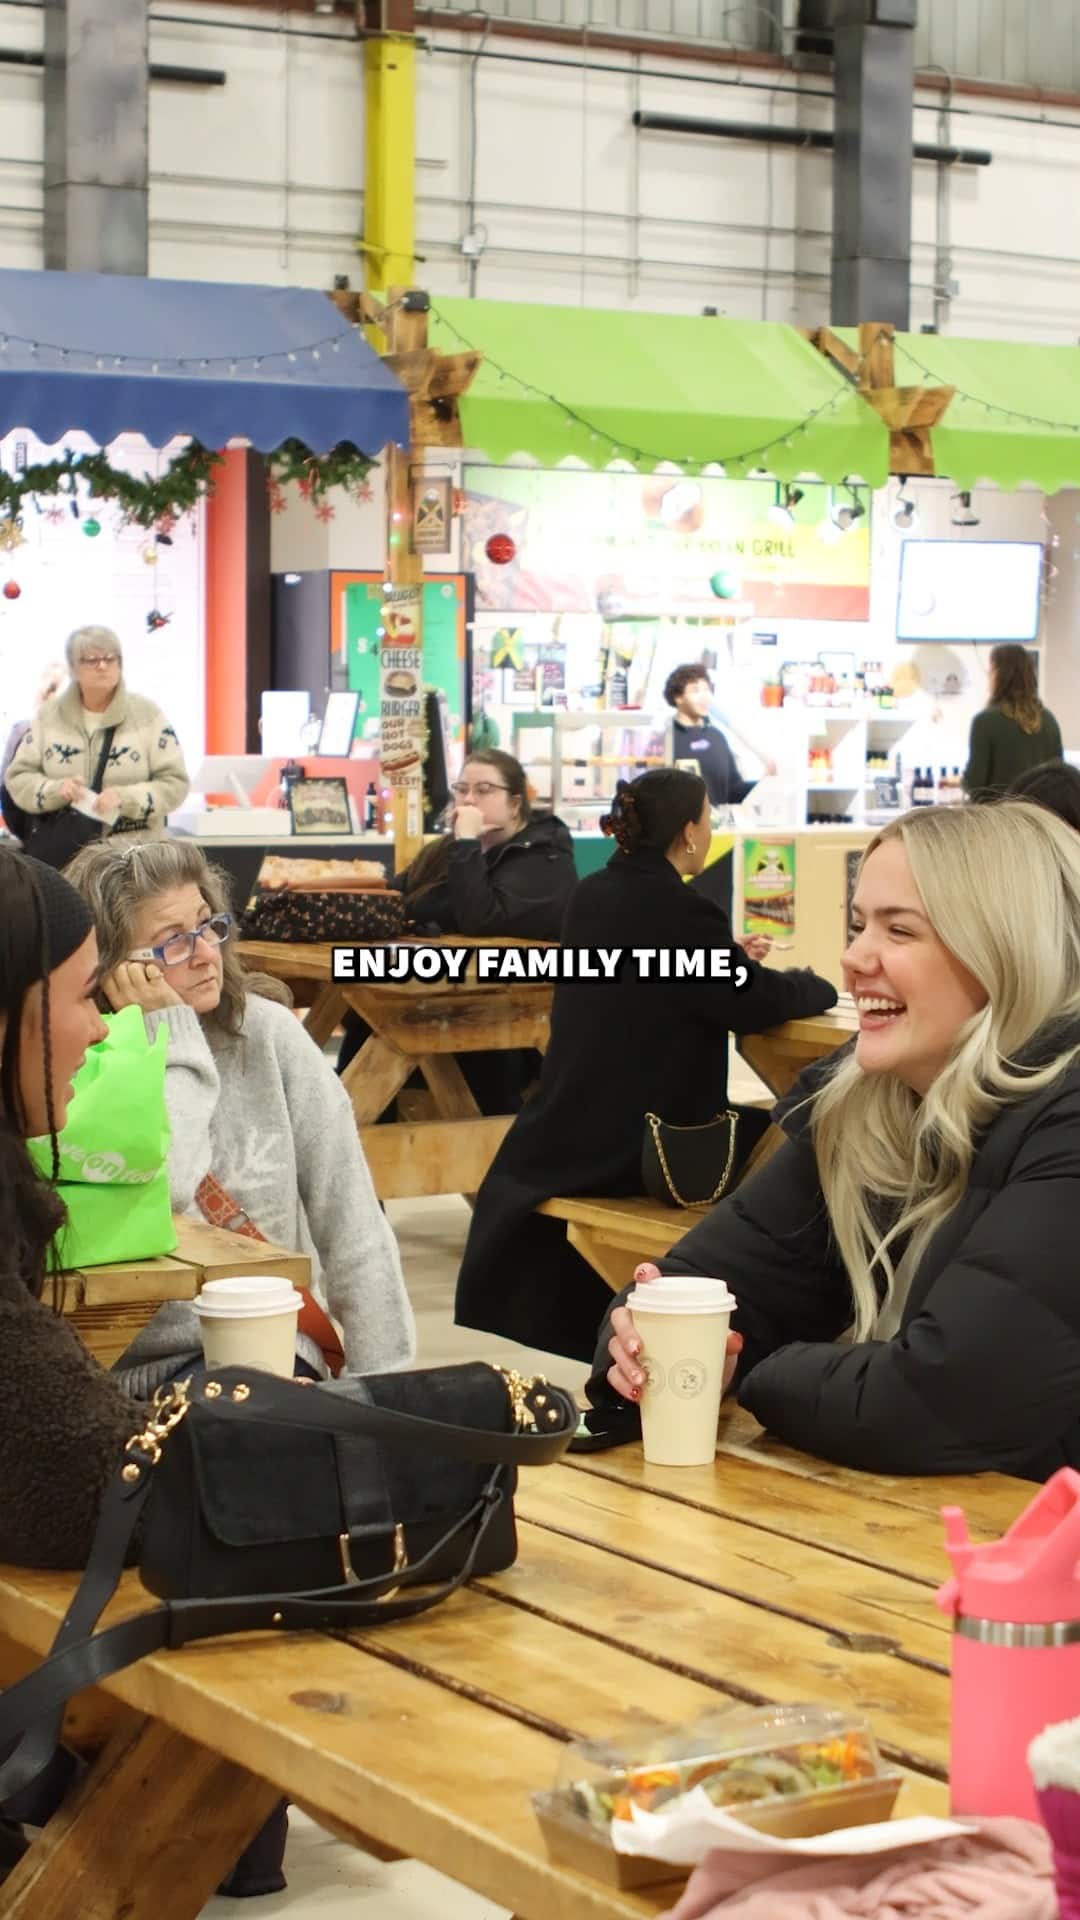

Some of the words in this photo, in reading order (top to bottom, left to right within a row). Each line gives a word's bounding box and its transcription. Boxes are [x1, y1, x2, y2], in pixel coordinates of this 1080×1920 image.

[752, 539, 796, 558] GRILL
[381, 650, 420, 669] CHEESE
[382, 719, 405, 729] OUR
[382, 730, 405, 740] HOT
[383, 741, 413, 752] DOGS
